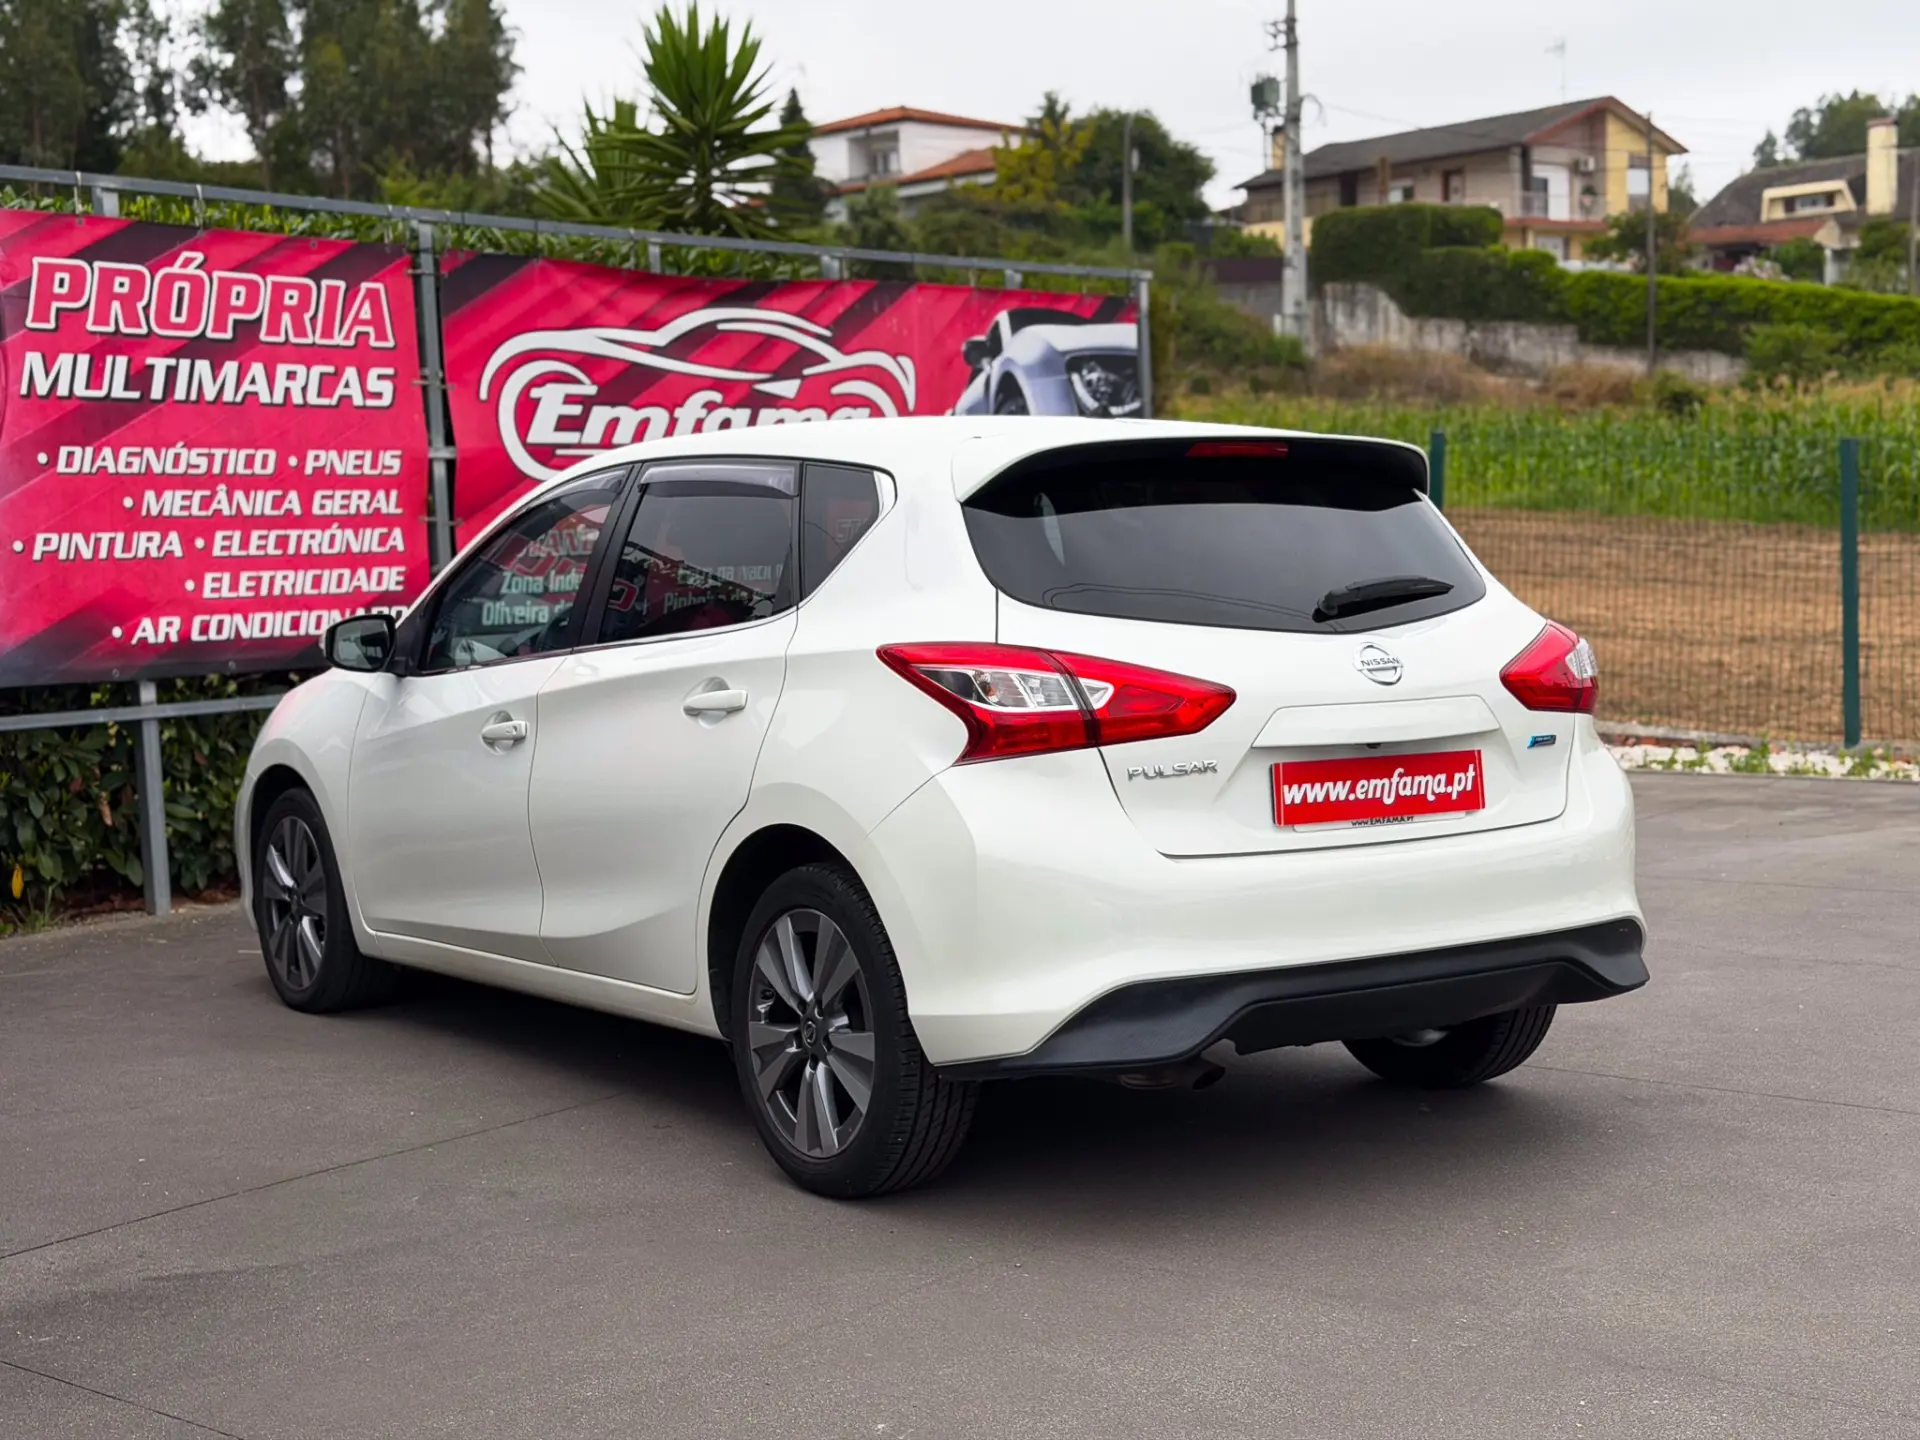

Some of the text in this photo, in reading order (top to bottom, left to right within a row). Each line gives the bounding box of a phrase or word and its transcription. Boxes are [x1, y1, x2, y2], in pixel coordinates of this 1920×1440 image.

[26, 251, 396, 348] PRÓPRIA
[20, 351, 395, 407] MULTIMARCAS
[56, 442, 401, 476] DIAGNÓSTICO PNEUS
[141, 484, 403, 517] MECÂNICA GERAL
[33, 524, 405, 561] PINTURA ELECTRÓNICA
[203, 566, 406, 599] ELETRICIDADE
[500, 571, 544, 595] Zona
[130, 616, 181, 645] AR
[482, 602, 549, 626] Oliveira
[1360, 657, 1400, 667] NISSAN
[1127, 760, 1217, 781] PULSAR
[1283, 763, 1476, 806] www.emfama.pt
